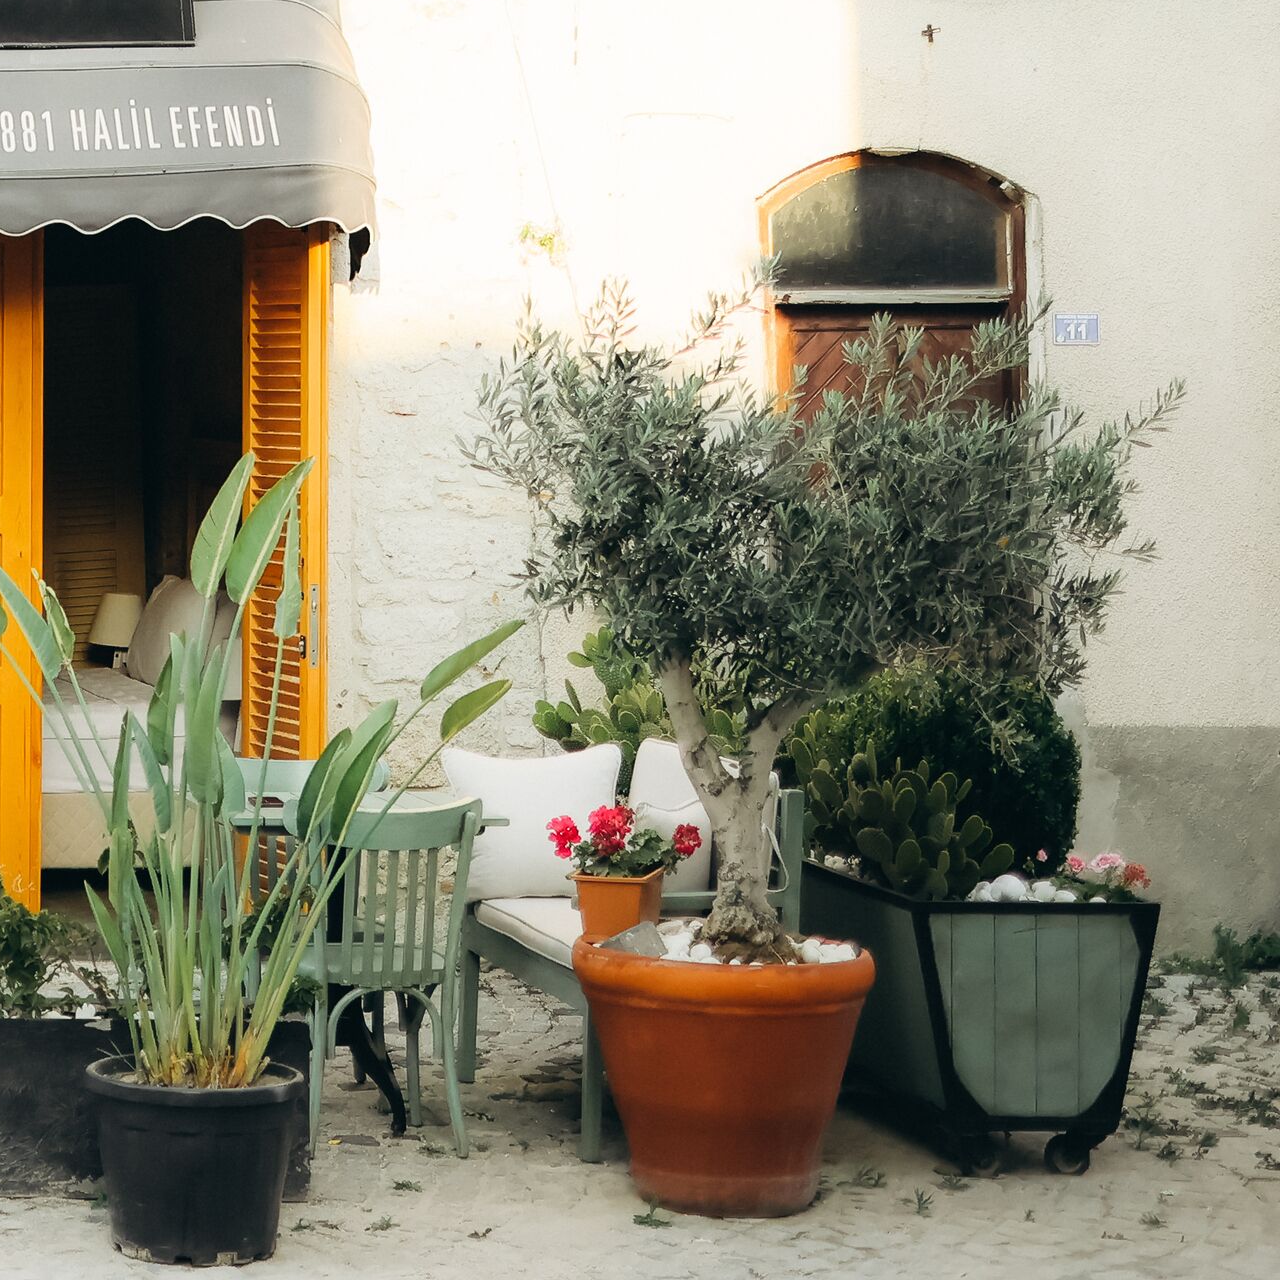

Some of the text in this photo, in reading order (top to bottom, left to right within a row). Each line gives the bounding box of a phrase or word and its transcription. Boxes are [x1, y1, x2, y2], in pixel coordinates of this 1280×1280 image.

[69, 99, 162, 152] HALİL
[169, 97, 282, 149] EFENDİ
[1066, 323, 1087, 340] 11
